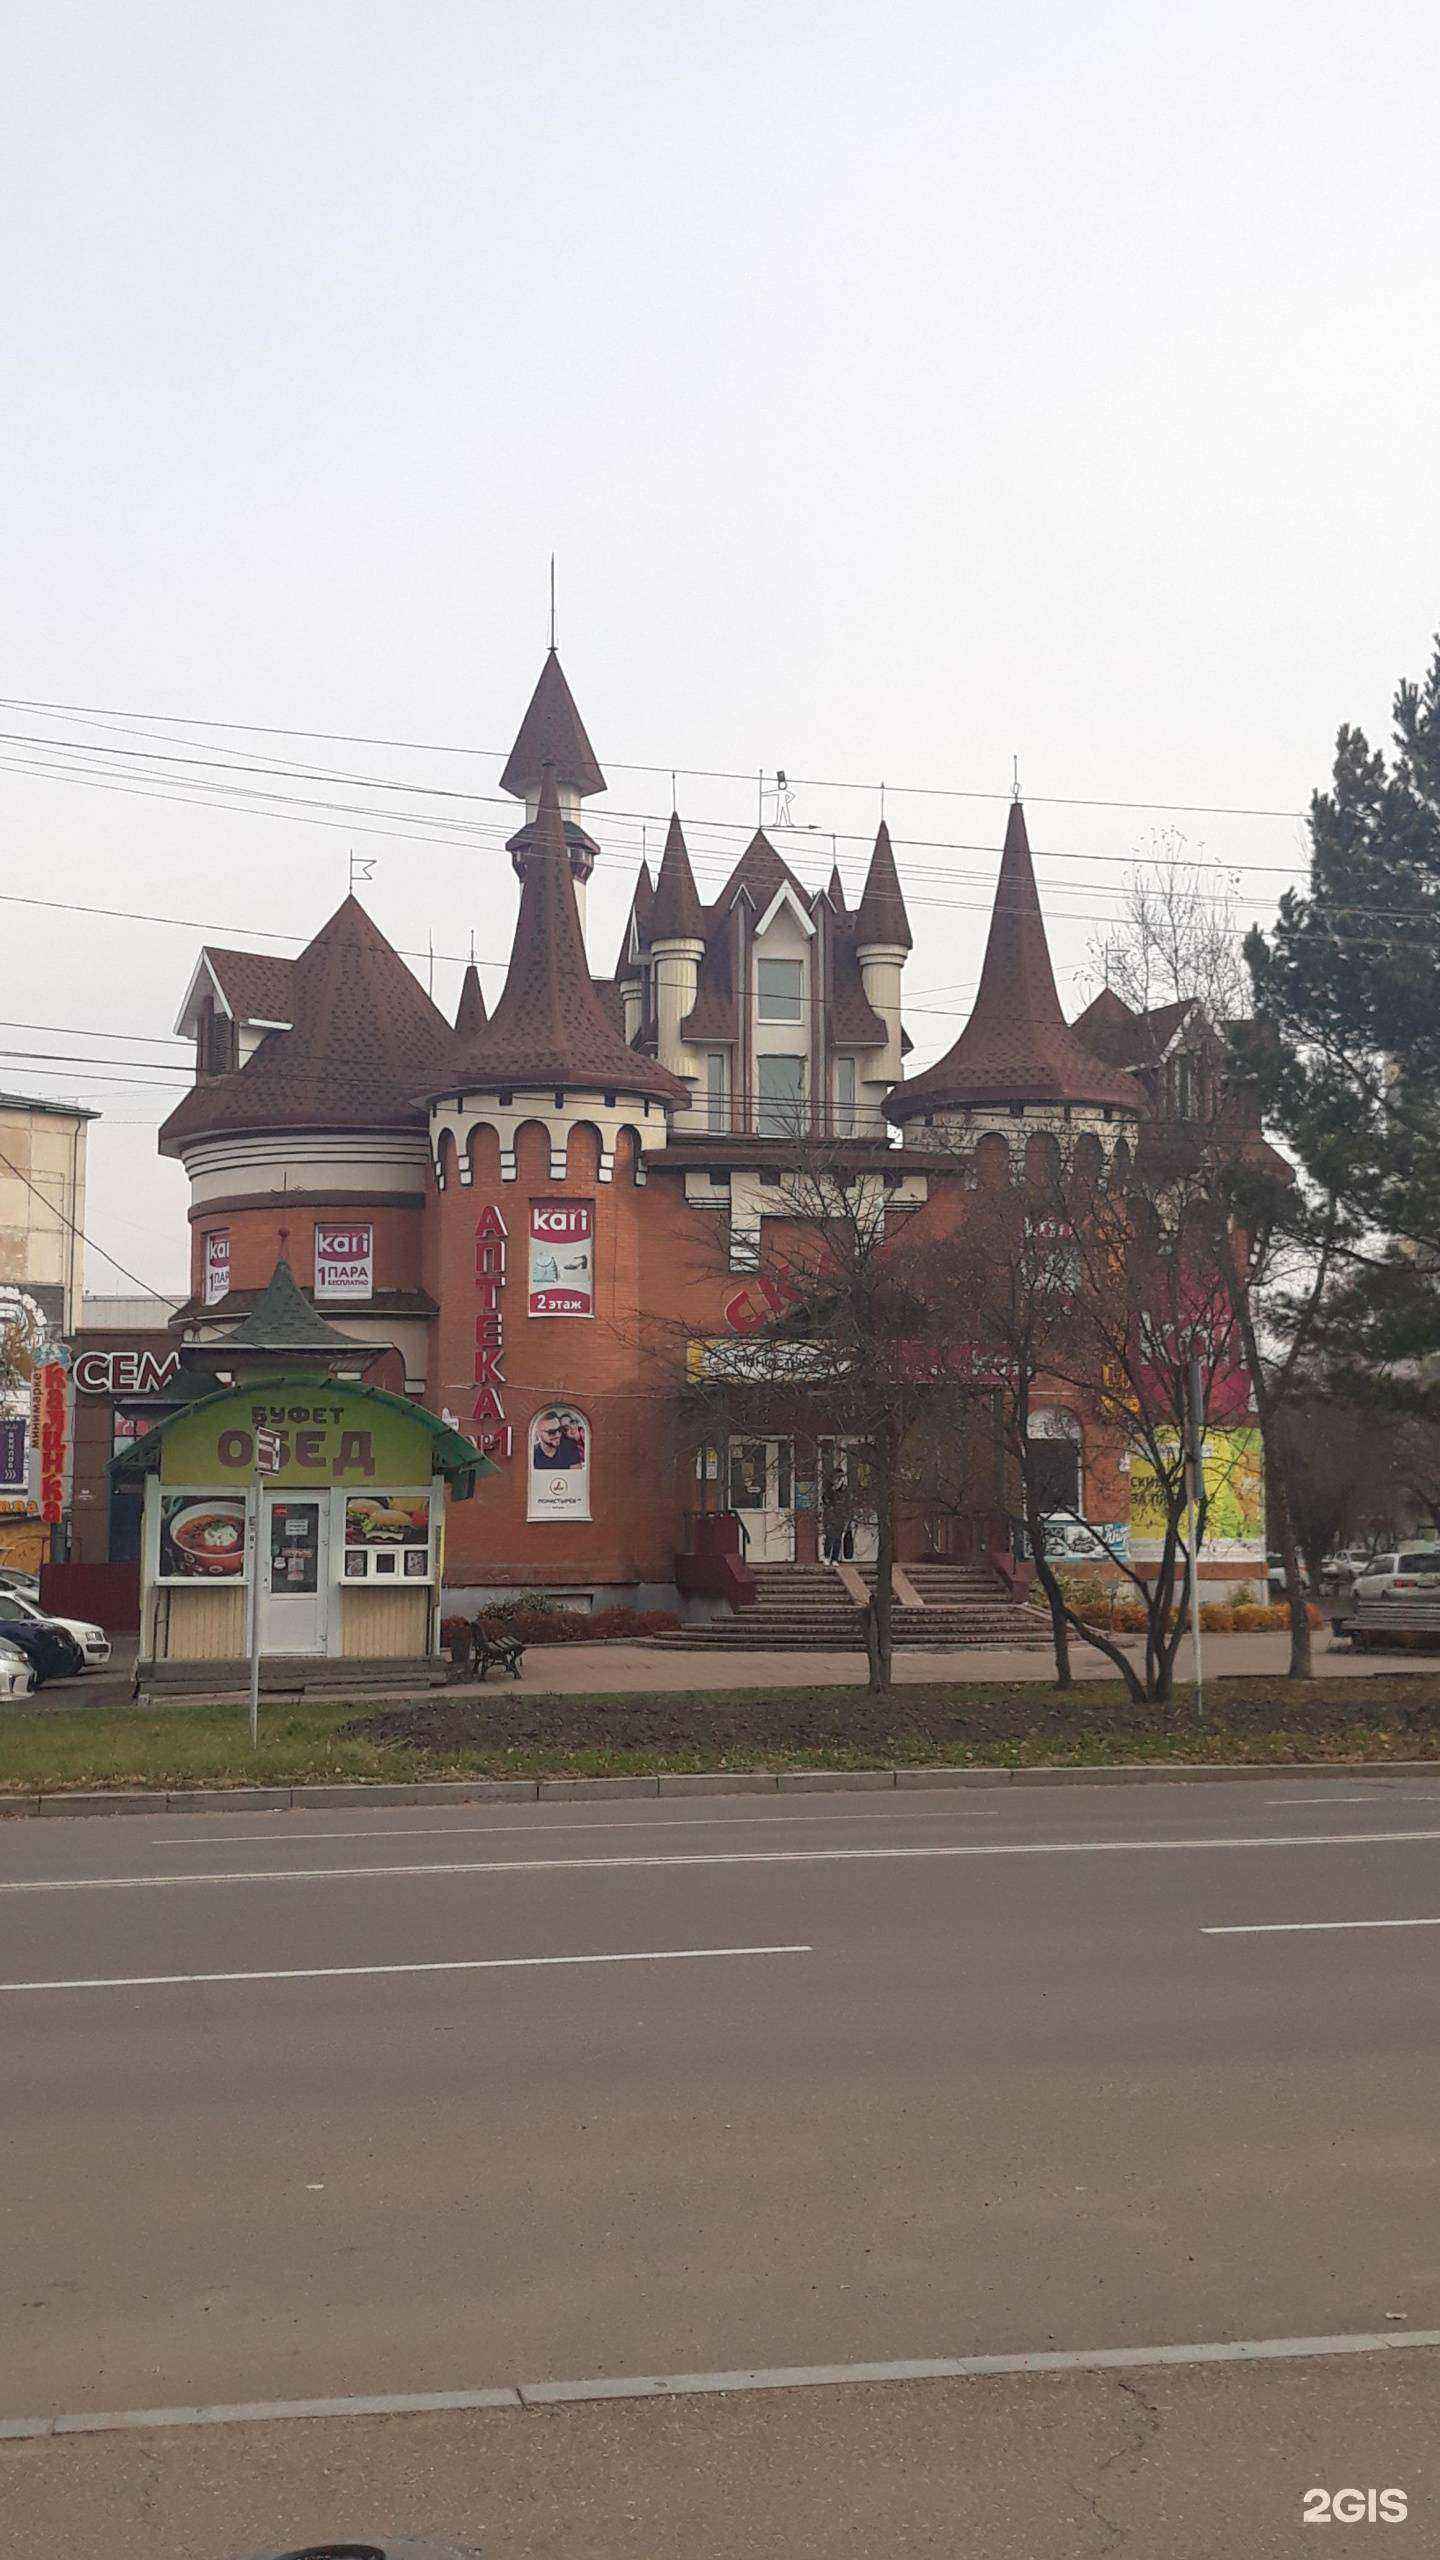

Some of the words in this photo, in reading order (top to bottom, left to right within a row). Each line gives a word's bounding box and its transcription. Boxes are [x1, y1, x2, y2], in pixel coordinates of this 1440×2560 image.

[533, 1208, 588, 1231] kari
[319, 1233, 369, 1253] kari
[317, 1268, 325, 1286] 1
[328, 1267, 368, 1278] ПАРА
[537, 1294, 546, 1309] 2
[549, 1300, 582, 1310] этаж
[475, 1205, 508, 1421] АПТЕКА
[251, 1406, 345, 1424] БУФЕТ
